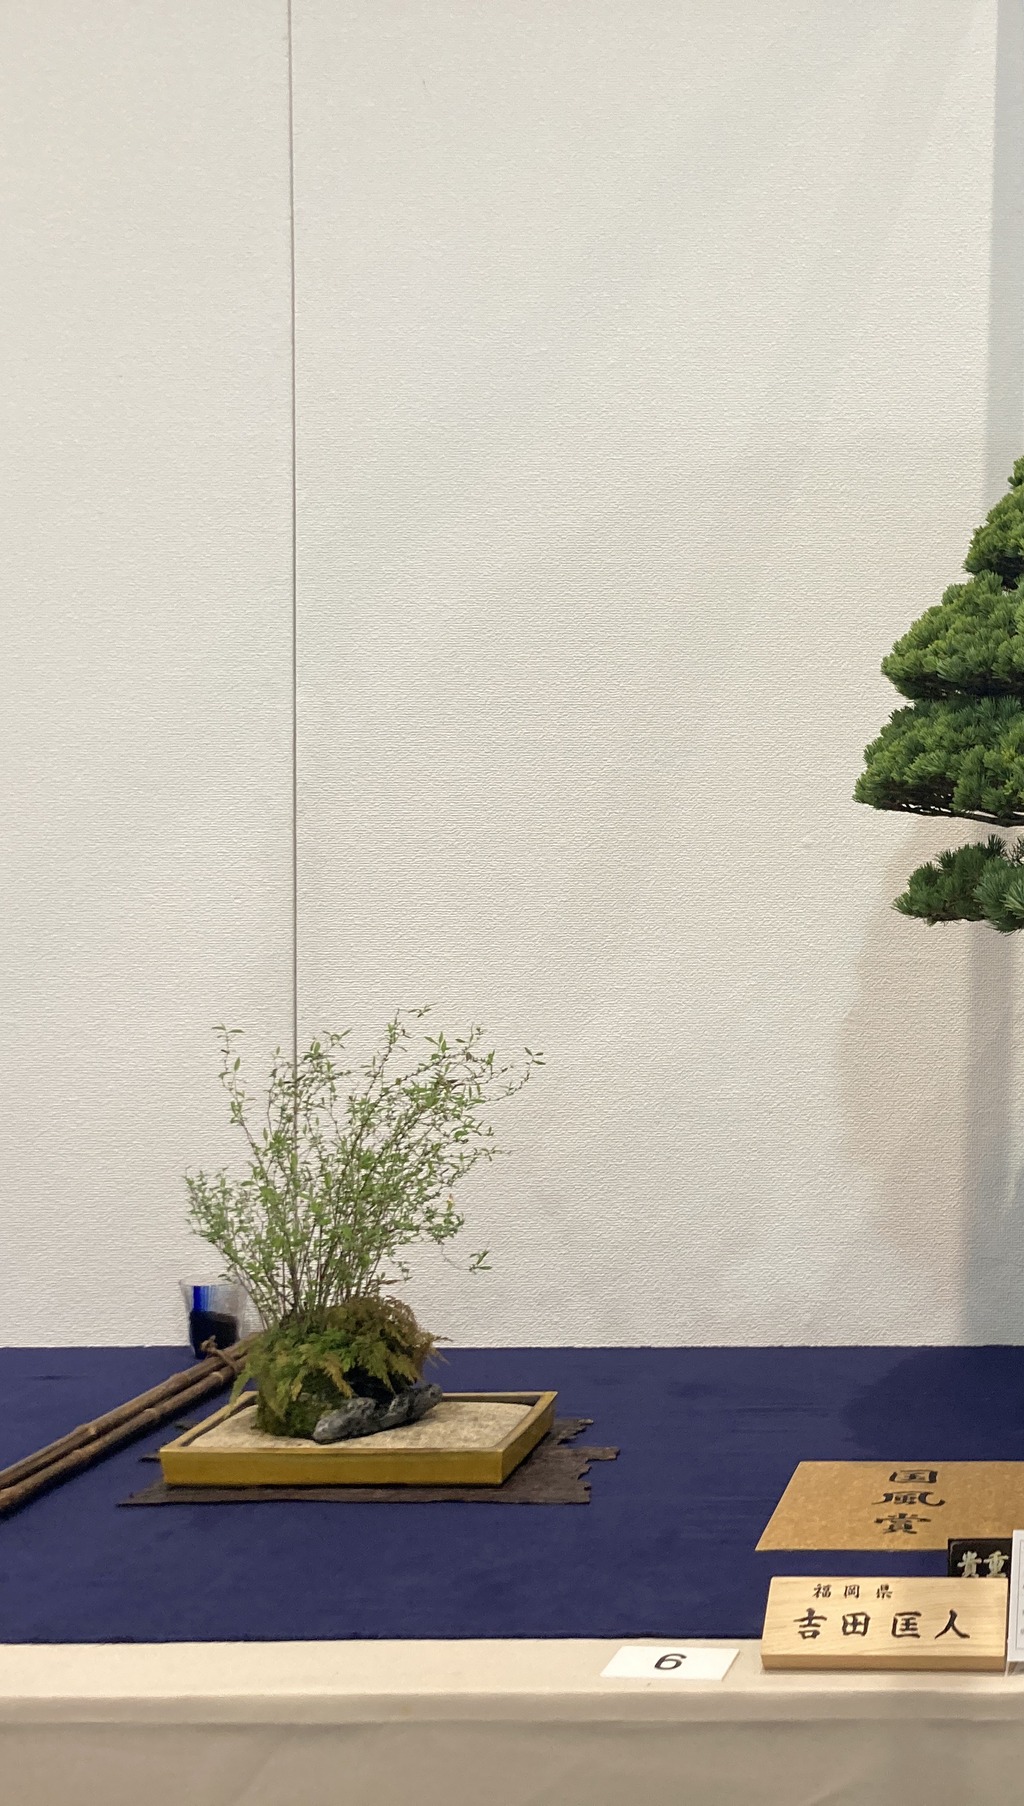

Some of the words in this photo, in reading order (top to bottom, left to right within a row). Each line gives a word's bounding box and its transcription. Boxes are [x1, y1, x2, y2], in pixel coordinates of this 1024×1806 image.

[872, 1469, 946, 1535] 国風賞
[813, 1584, 894, 1600] 福岡県
[793, 1608, 970, 1641] 吉田匡人
[653, 1653, 687, 1671] 6
